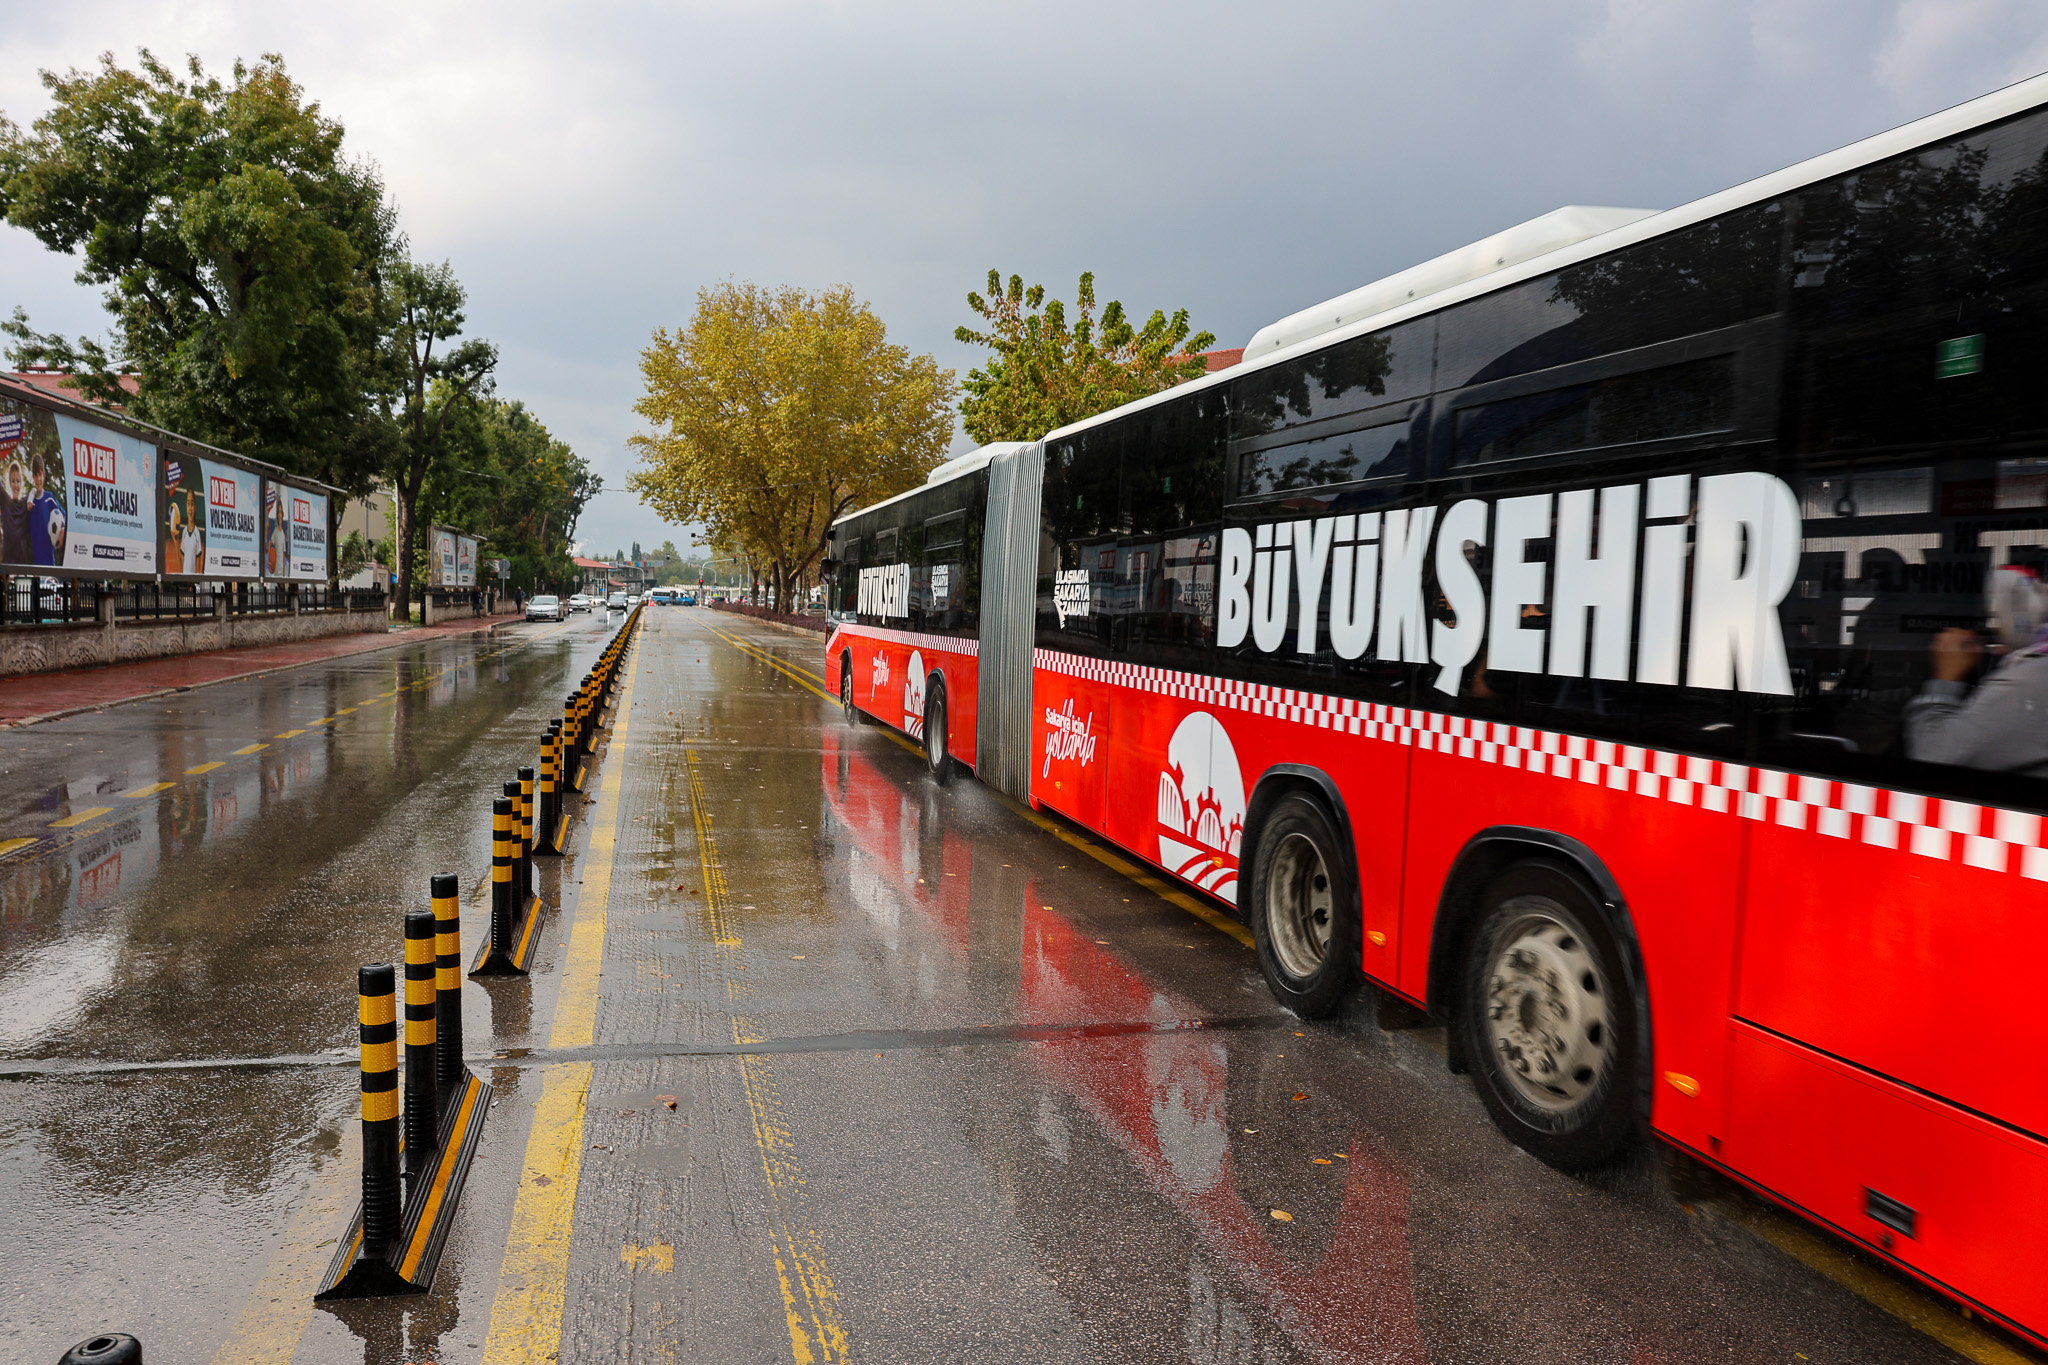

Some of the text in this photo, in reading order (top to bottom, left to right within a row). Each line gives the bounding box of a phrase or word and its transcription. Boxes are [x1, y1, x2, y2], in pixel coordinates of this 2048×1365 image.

[75, 442, 89, 475] 10
[74, 481, 138, 517] FUTBOL SAHASI
[211, 479, 220, 503] 10
[210, 508, 237, 530] VOLEYBOL
[1055, 569, 1089, 584] ULAŞIMDA
[1216, 471, 1802, 697] BÜYÜKŞEHİR
[1054, 584, 1090, 601] SAKARYA
[1062, 601, 1090, 616] ZAMANI
[1045, 707, 1085, 736] Sakarya için
[1043, 698, 1097, 778] yollarda
